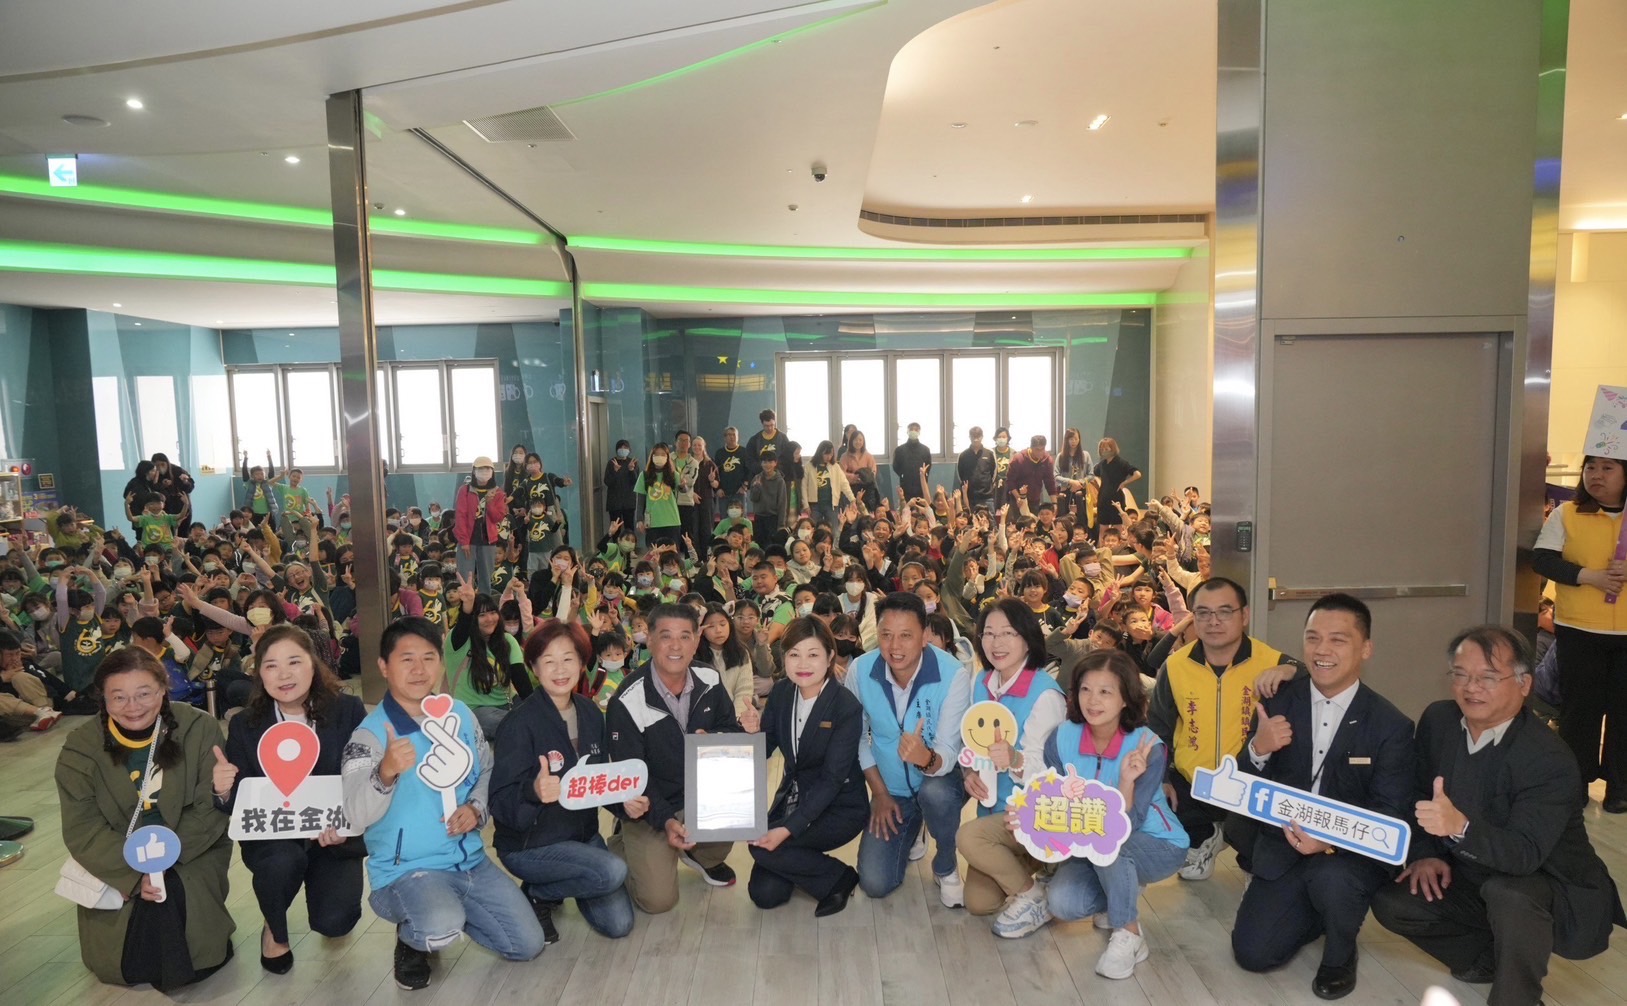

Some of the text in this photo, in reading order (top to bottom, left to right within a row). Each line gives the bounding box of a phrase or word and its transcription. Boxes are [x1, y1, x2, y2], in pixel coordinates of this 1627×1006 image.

[566, 773, 641, 799] 超棒der
[1033, 794, 1107, 837] 超讚
[1276, 797, 1371, 842] 金湖報馬仔
